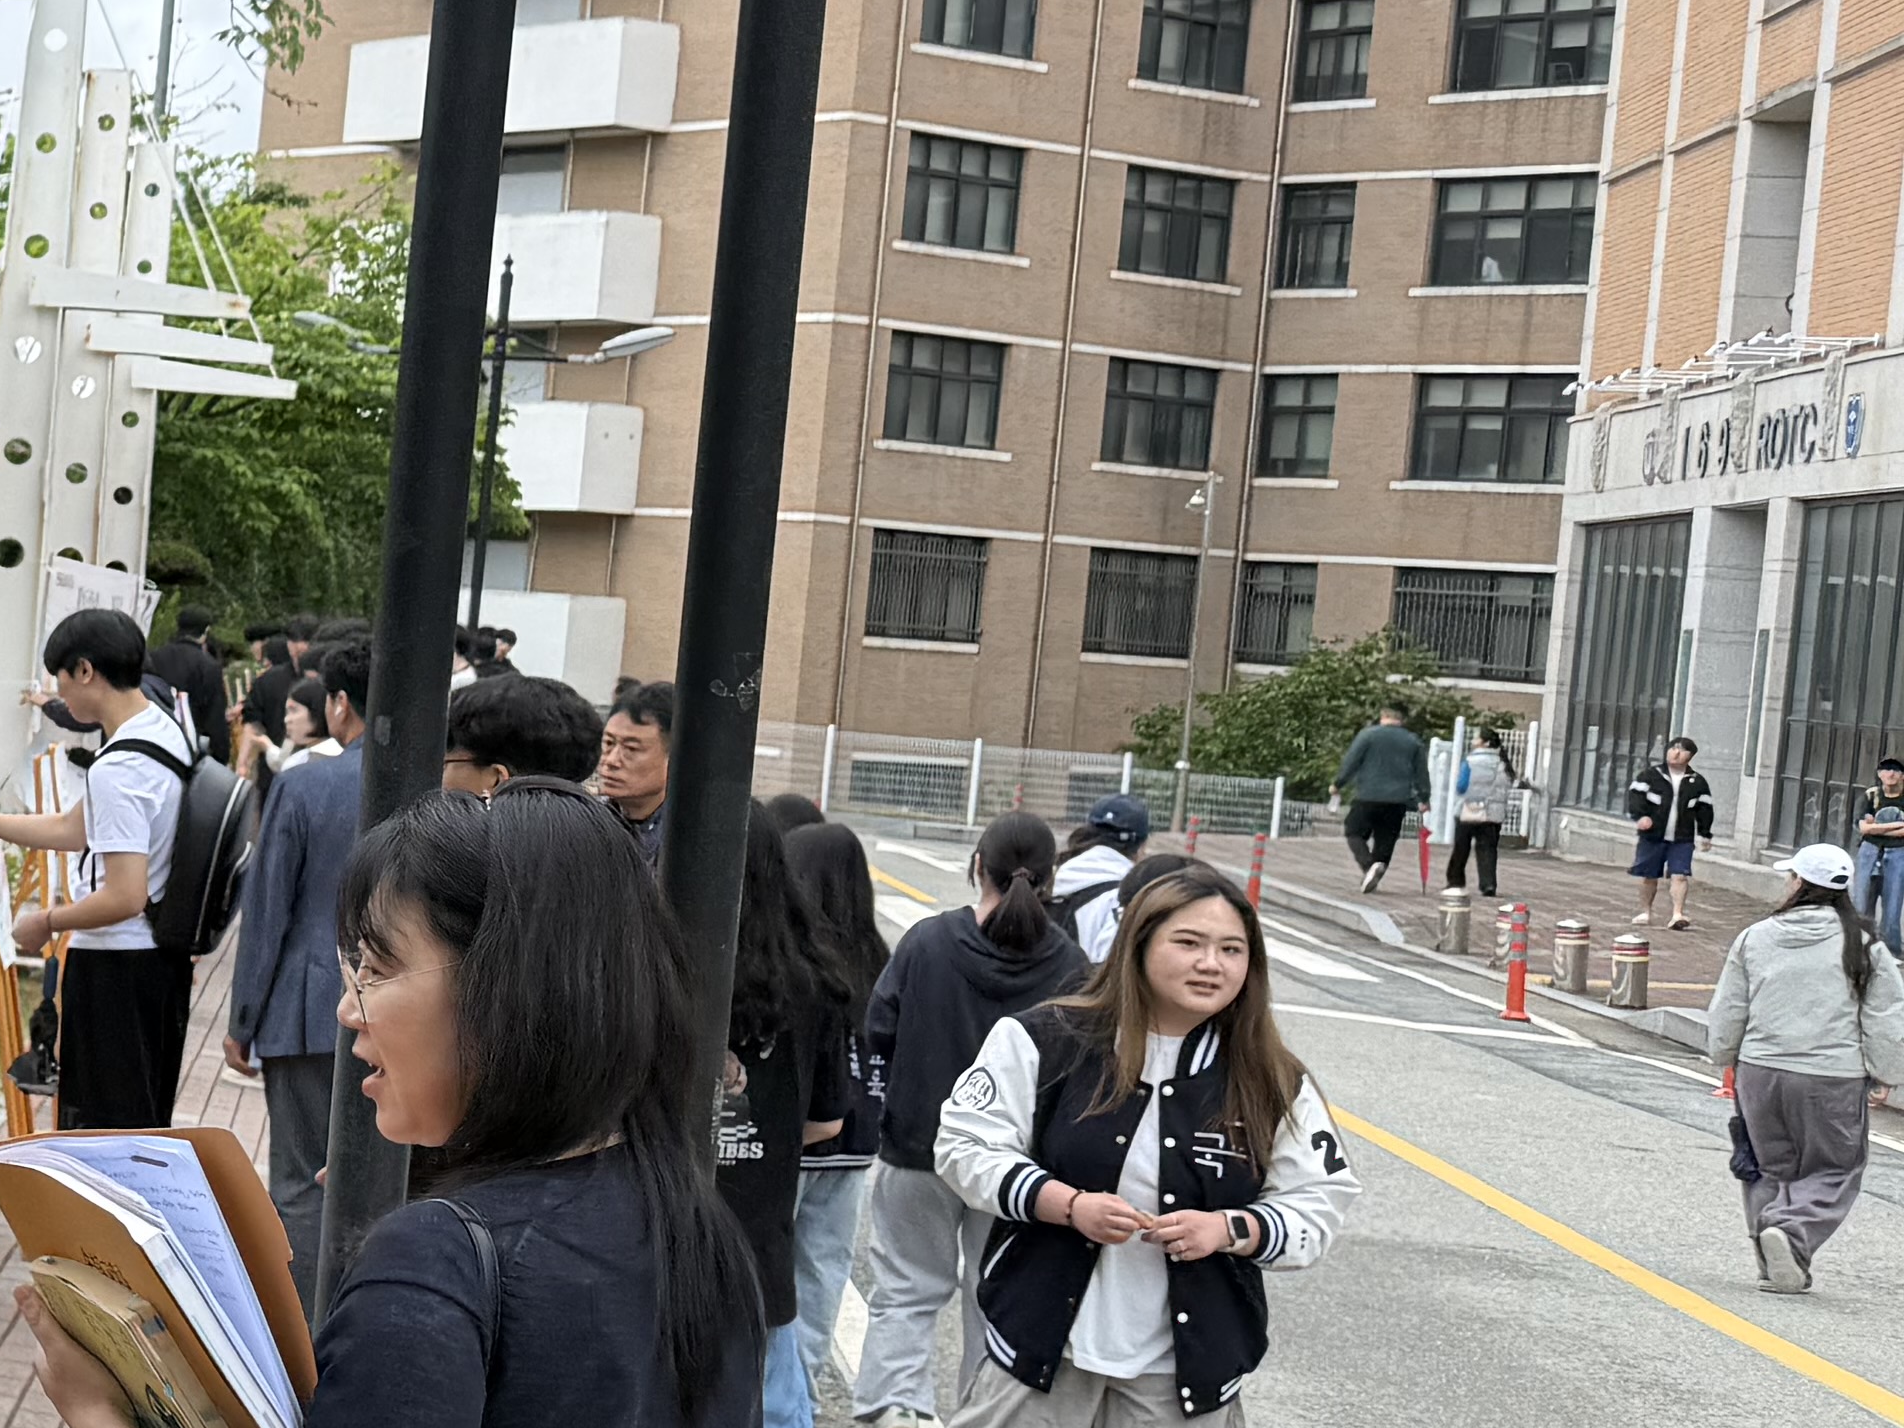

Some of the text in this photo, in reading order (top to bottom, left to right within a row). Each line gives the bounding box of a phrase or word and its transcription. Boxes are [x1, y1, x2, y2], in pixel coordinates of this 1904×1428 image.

[1754, 402, 1819, 471] ROTC
[717, 1140, 764, 1159] IBES
[1310, 1129, 1348, 1176] 2
